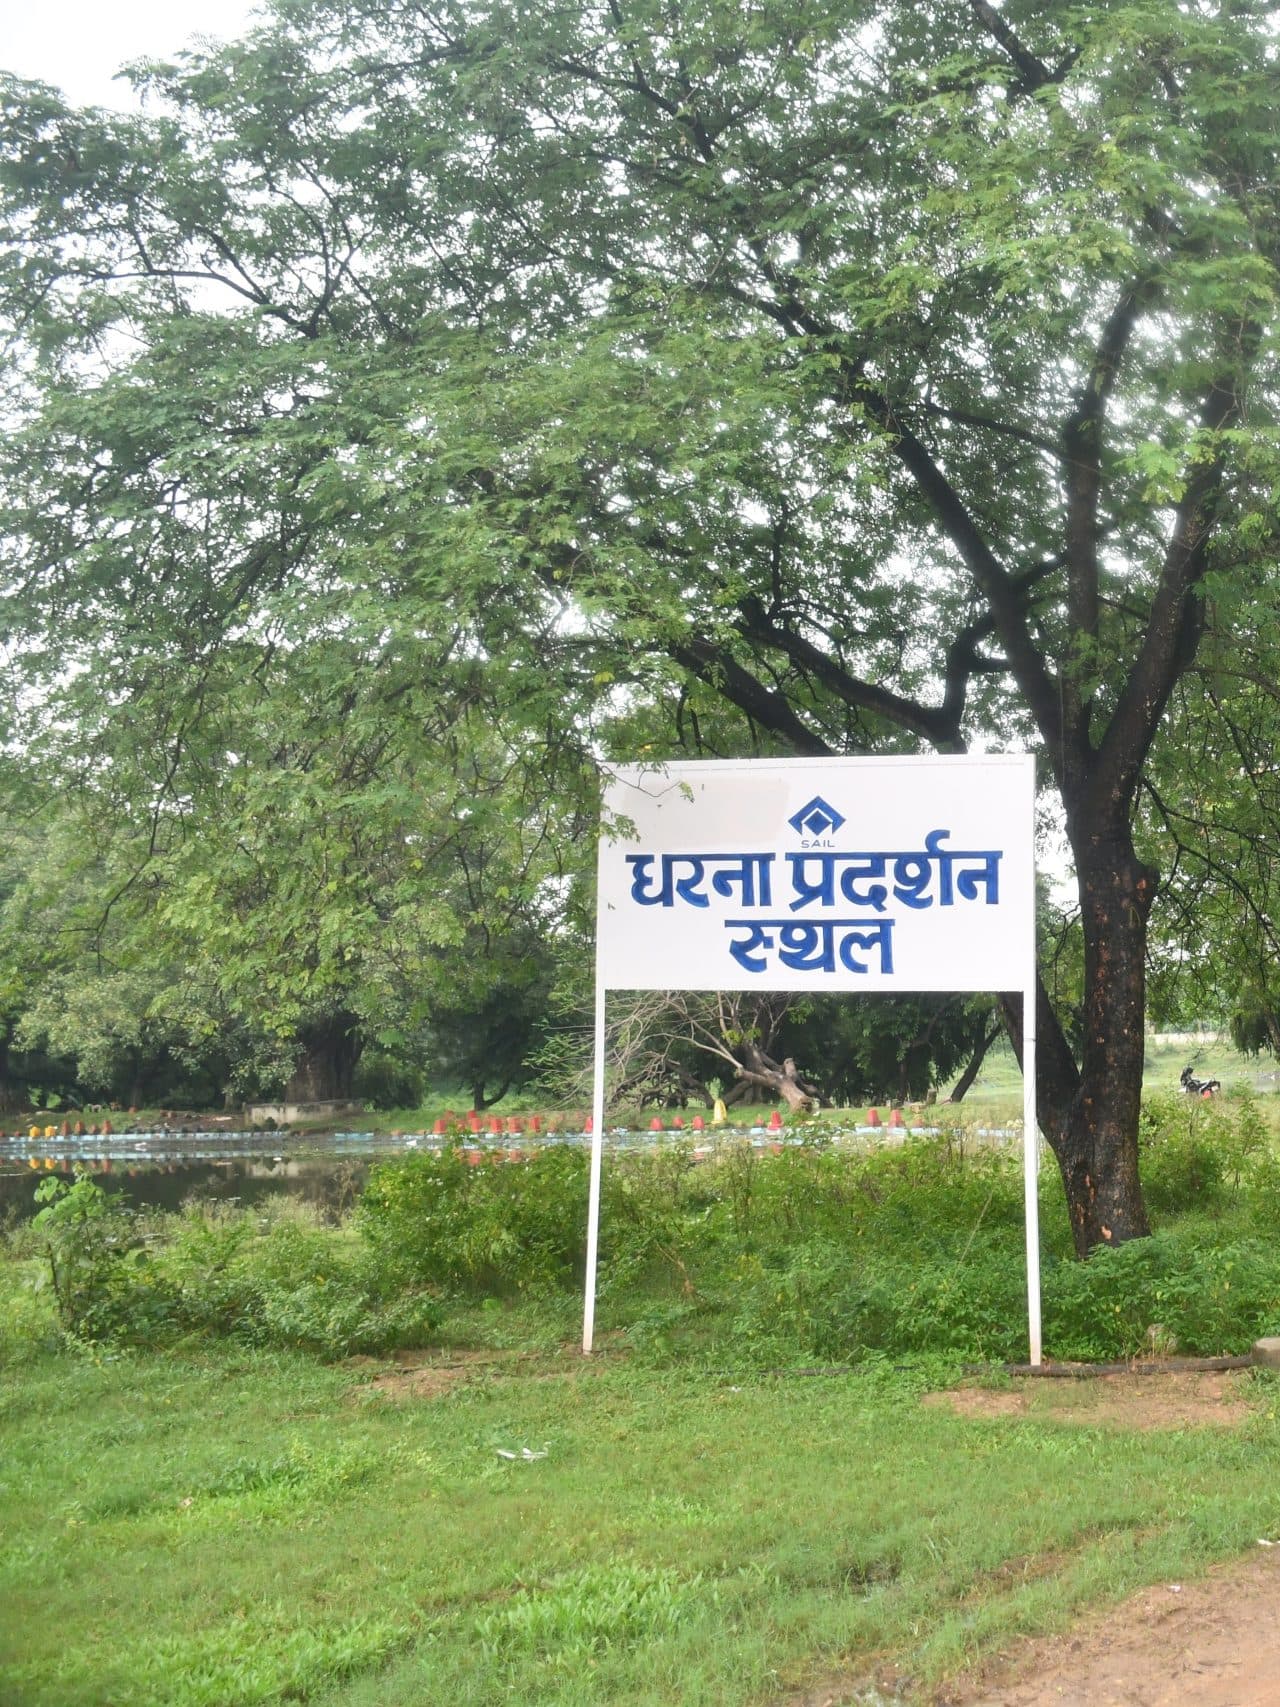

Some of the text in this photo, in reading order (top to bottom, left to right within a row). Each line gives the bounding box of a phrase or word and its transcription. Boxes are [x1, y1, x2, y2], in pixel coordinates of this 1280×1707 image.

[625, 829, 1003, 912] धरना प्रदर्शन
[800, 839, 835, 849] SAIL
[724, 918, 896, 974] स्थल
